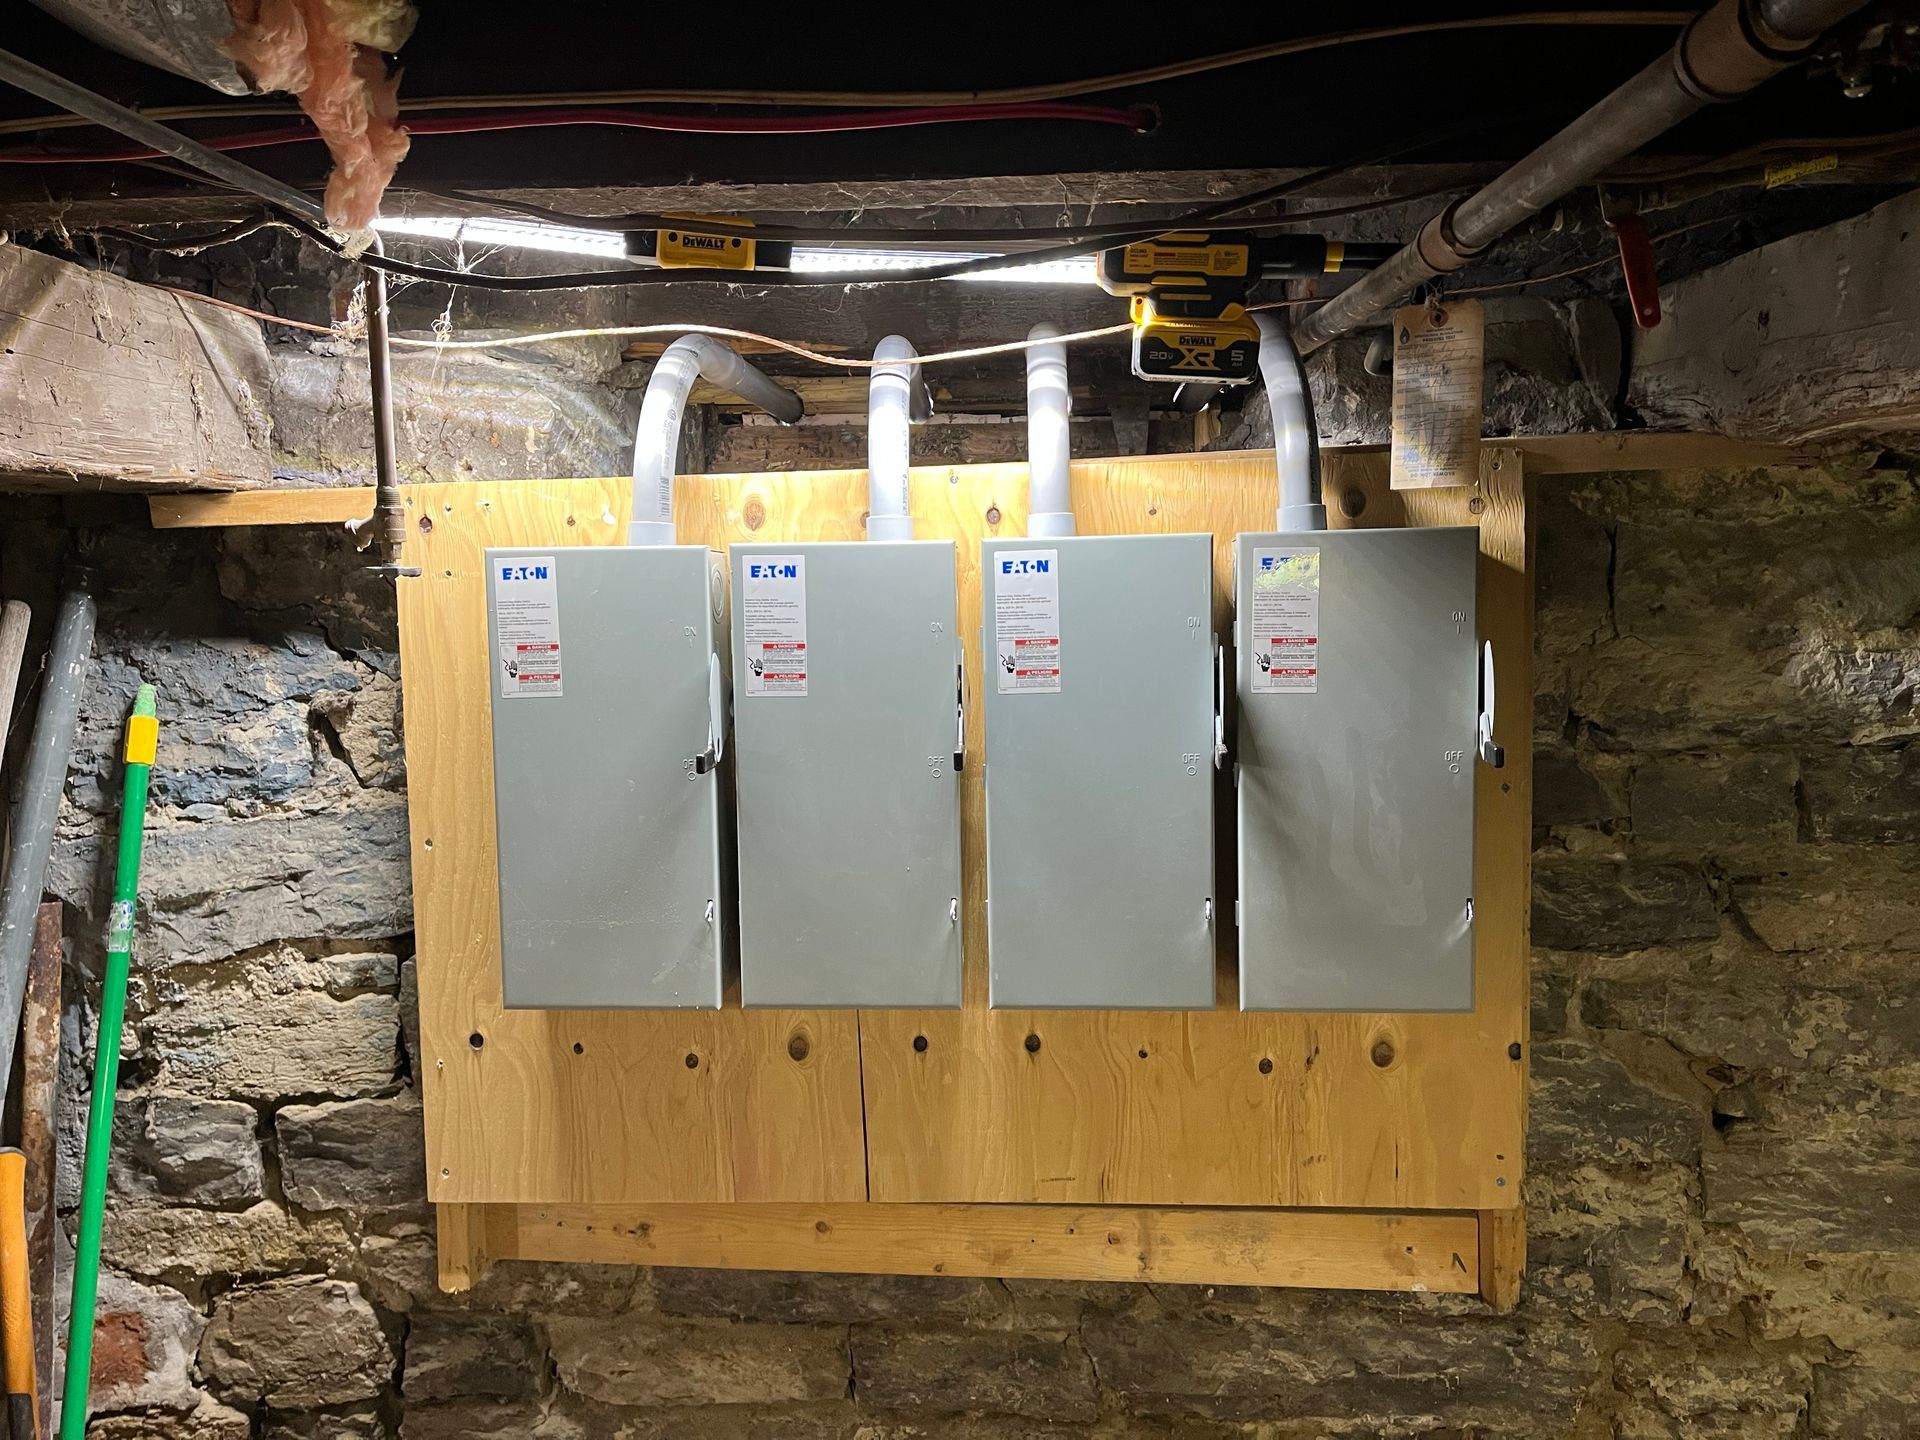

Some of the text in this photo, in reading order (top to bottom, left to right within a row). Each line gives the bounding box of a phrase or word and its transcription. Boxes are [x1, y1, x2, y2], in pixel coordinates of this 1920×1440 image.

[1230, 349, 1245, 361] 5
[750, 565, 797, 578] EATON
[1002, 560, 1049, 573] EATON
[502, 566, 548, 580] EATON
[1187, 616, 1200, 627] ON
[1452, 611, 1466, 622] ON
[927, 756, 945, 767] OFF
[1182, 753, 1201, 764] OFF
[1444, 751, 1464, 762] OFF
